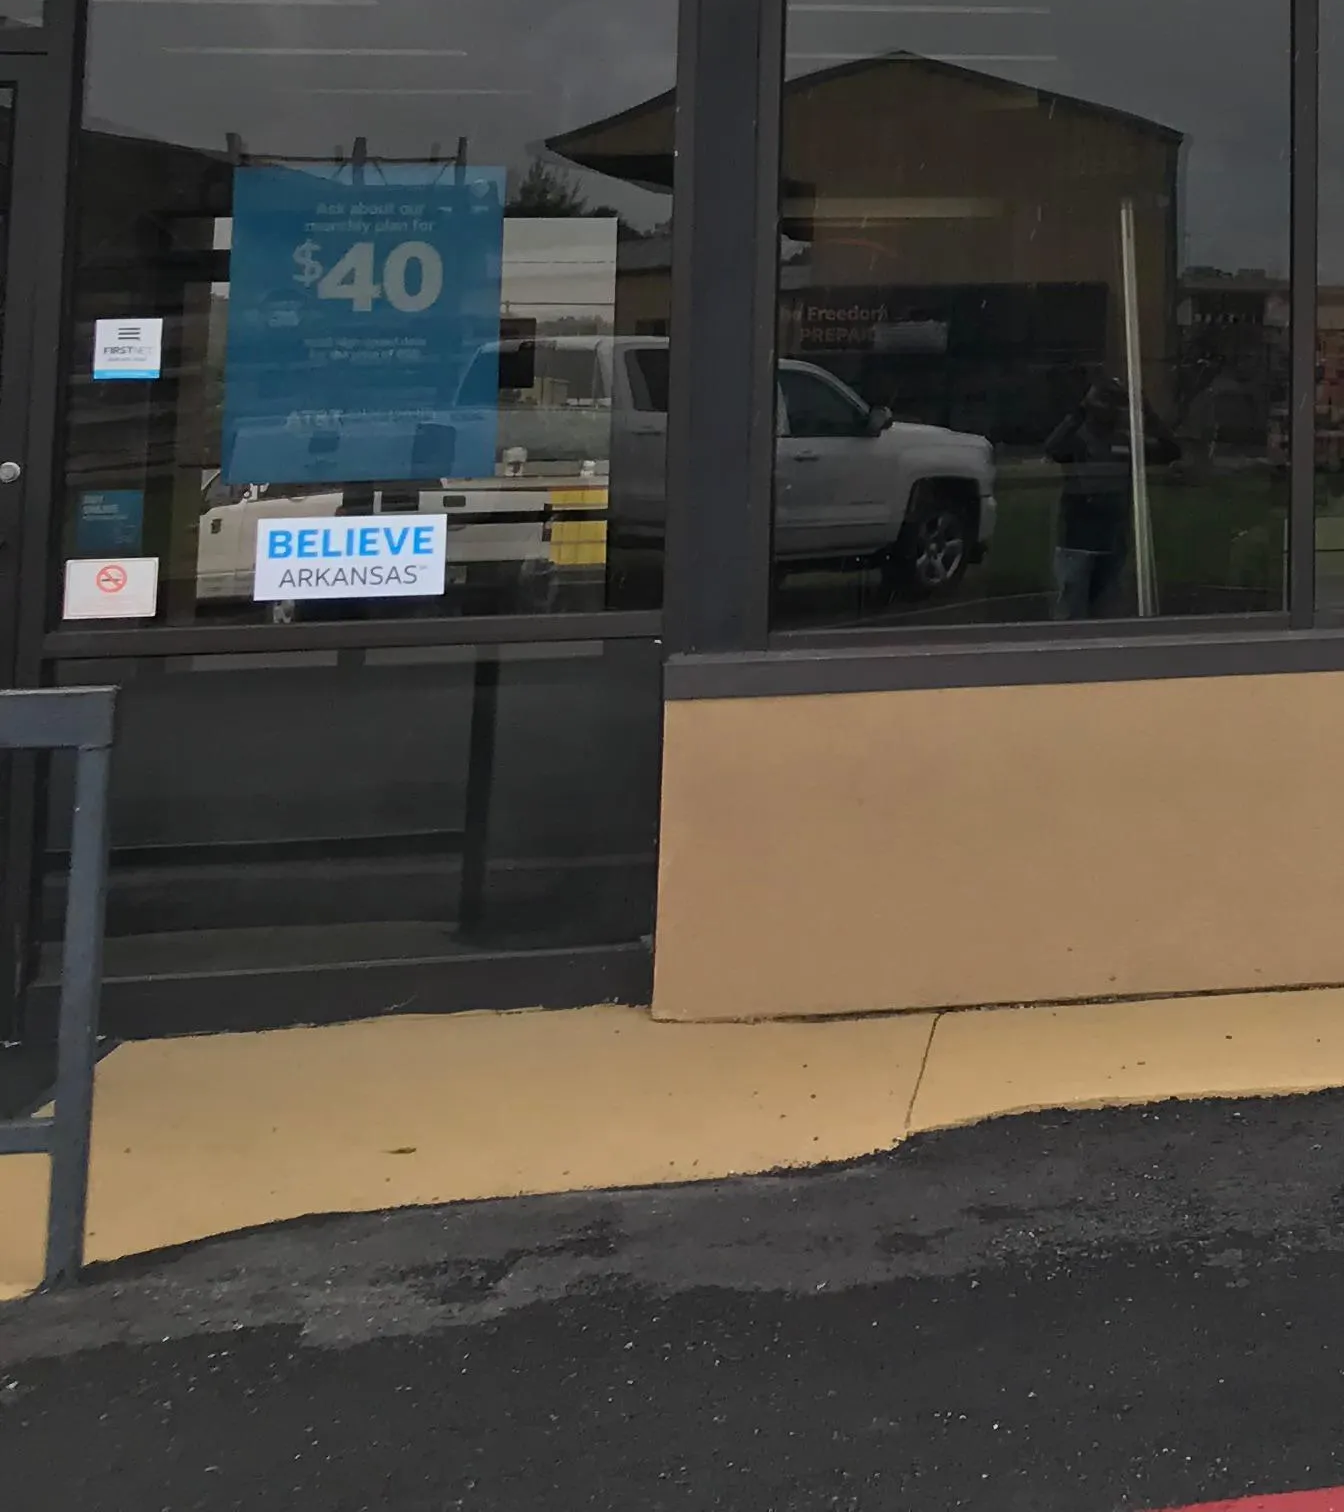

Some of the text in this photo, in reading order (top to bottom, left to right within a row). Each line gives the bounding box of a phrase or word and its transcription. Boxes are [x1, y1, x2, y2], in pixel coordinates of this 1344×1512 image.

[350, 201, 396, 216] about
[291, 239, 443, 313] $40
[268, 526, 435, 559] BELIEVE
[278, 565, 418, 588] ARKANSAS
